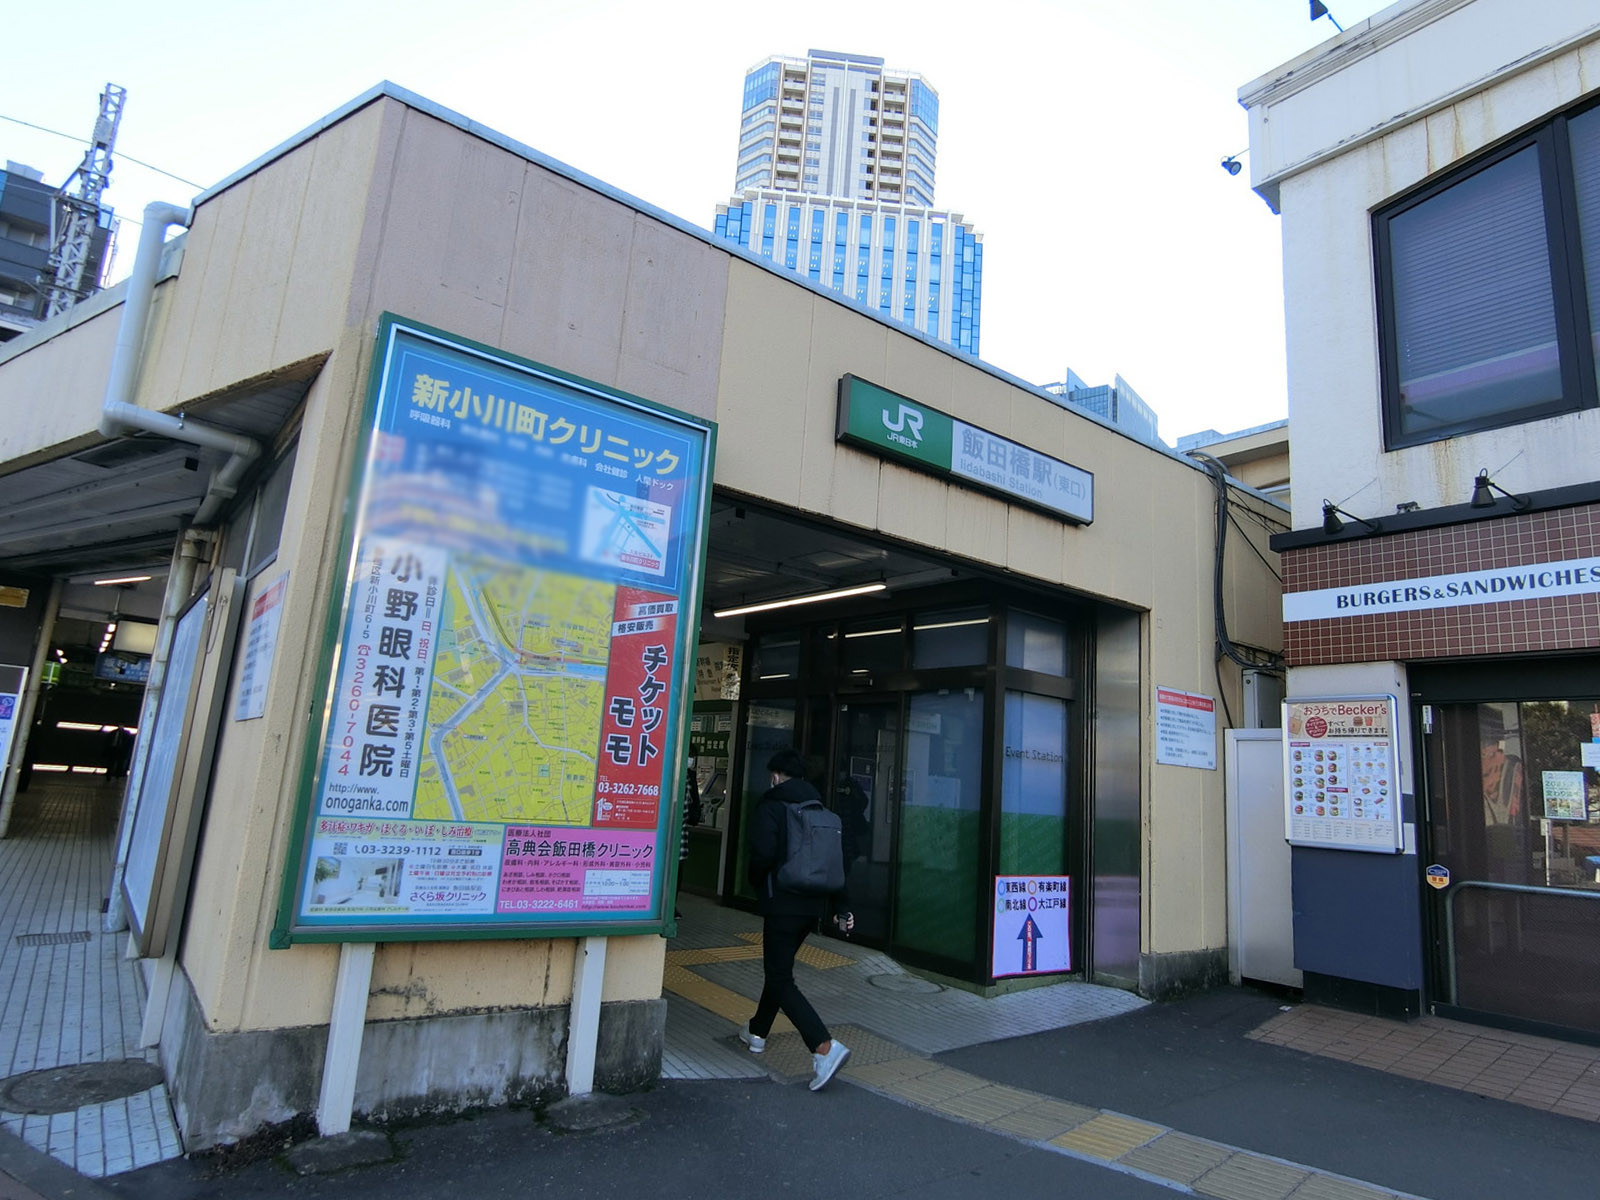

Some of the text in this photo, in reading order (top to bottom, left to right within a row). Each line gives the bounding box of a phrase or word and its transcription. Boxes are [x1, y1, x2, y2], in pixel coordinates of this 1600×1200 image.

[411, 374, 680, 475] 新小川町クリニック
[882, 403, 923, 441] JR
[886, 432, 918, 449] JR東日本
[960, 459, 1043, 498] Iidabashi Station
[617, 620, 654, 634] 格安販売
[359, 553, 422, 778] 小野眼科医院
[637, 644, 668, 767] チケット
[604, 696, 636, 766] モモ
[328, 783, 380, 795] http://www.
[598, 782, 659, 797] 03-3262-7668
[325, 796, 409, 813] onoganka.com
[361, 845, 442, 856] 03-3239-1112
[1038, 881, 1067, 893] 有楽町線
[409, 891, 487, 902] さくら坂クリニック
[1005, 898, 1067, 911] 南北線 大江戸線
